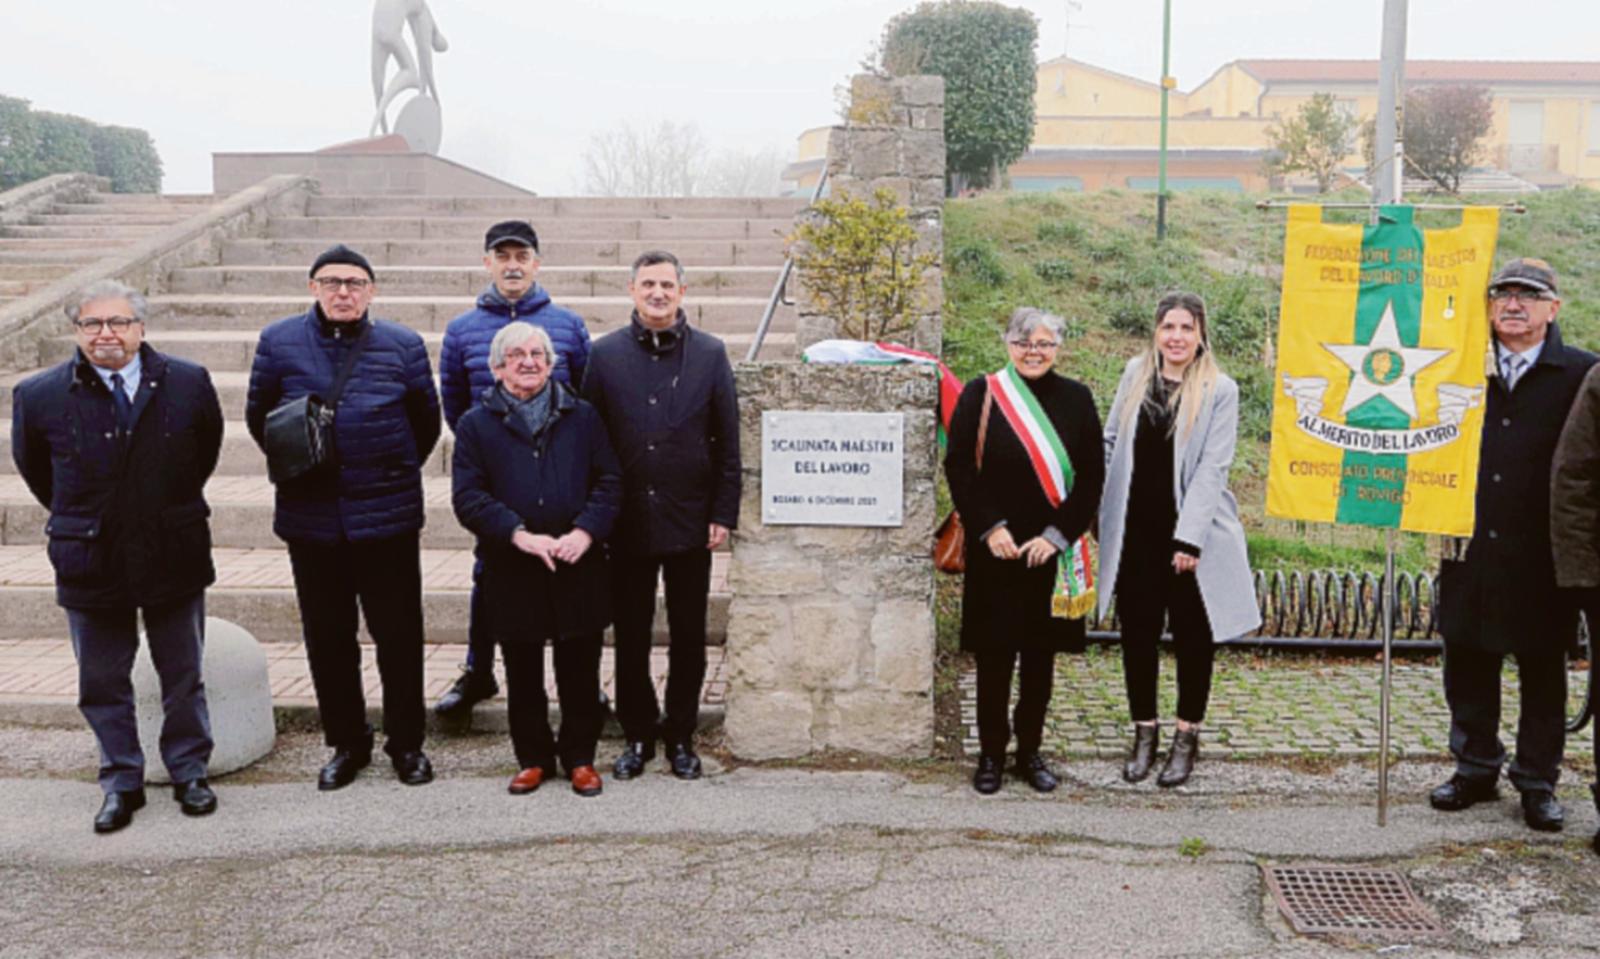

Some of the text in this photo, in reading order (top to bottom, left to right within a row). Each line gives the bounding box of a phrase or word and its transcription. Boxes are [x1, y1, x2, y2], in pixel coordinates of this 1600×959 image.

[1304, 244, 1391, 264] FEDERAZIONE
[1396, 247, 1418, 261] DEI
[1320, 267, 1345, 283] DEL
[1348, 268, 1402, 286] LAVORO
[1298, 415, 1458, 450] AL MERITO DEL LAVORO
[771, 439, 895, 453] SCALINATA MAESTRI
[794, 460, 871, 475] DEL LAVORO
[1289, 460, 1458, 489] CONSOLATO PROVINCIALE
[1358, 486, 1411, 505] ROVIGO
